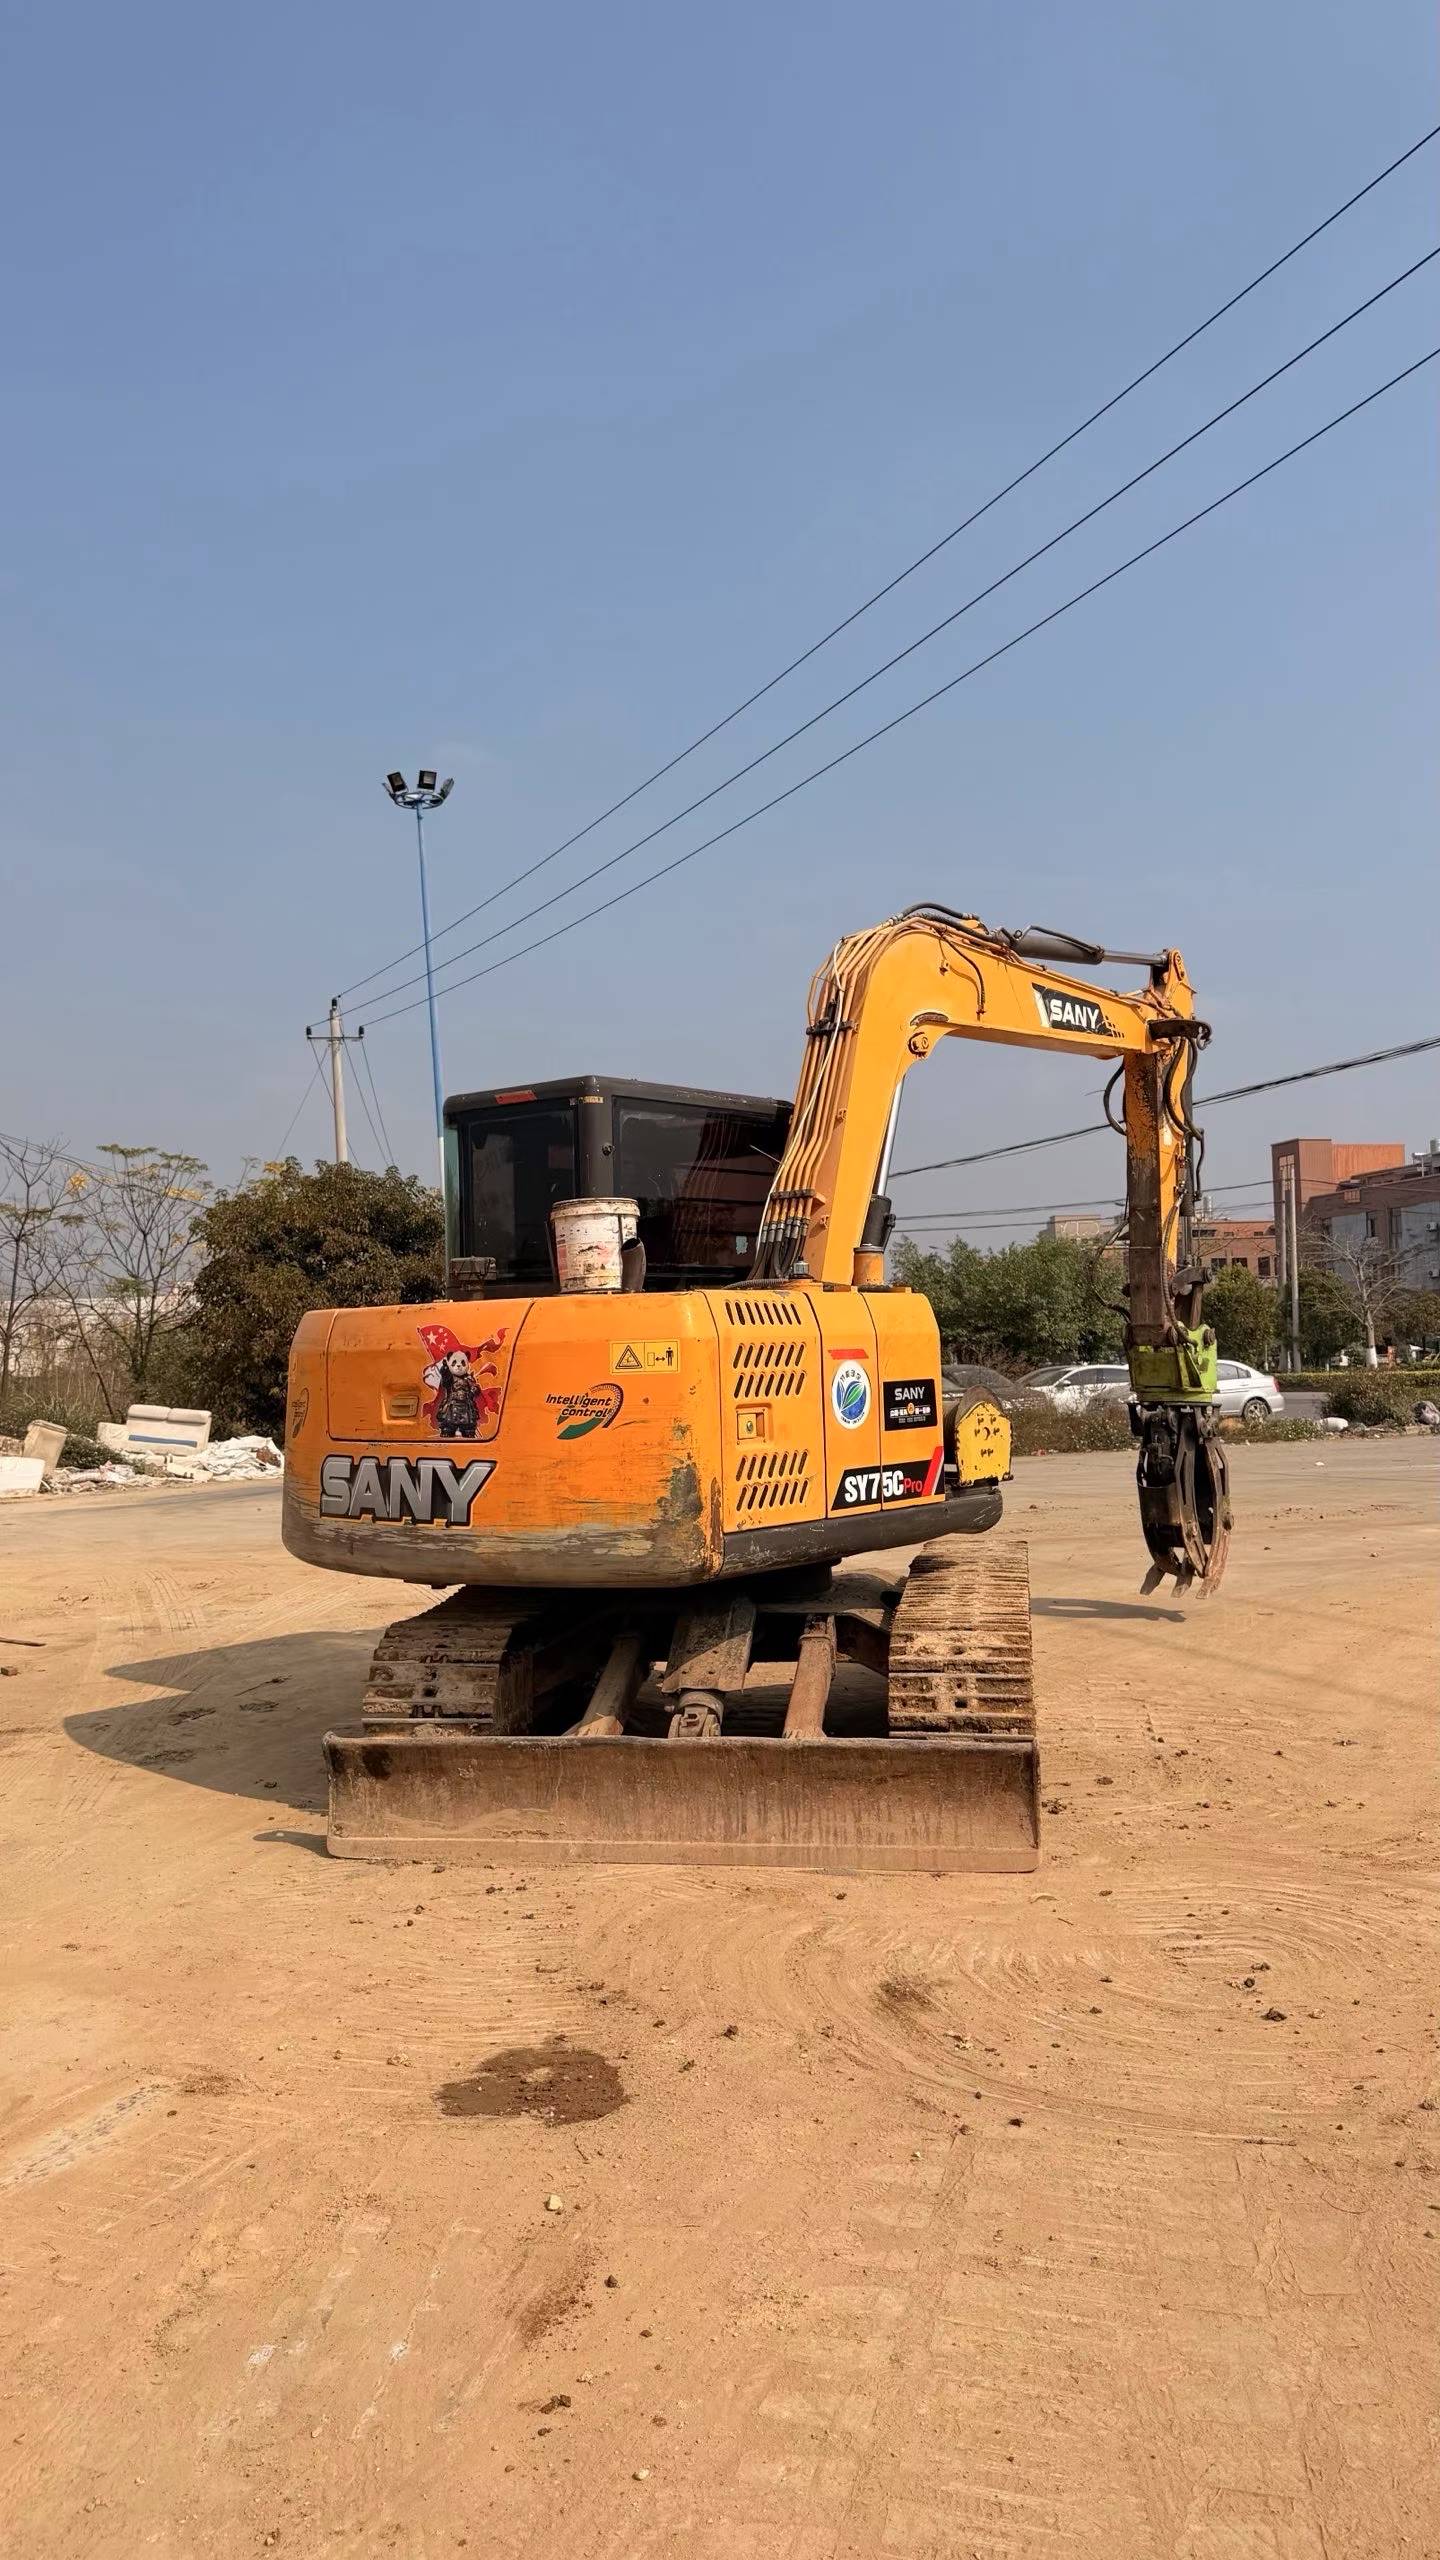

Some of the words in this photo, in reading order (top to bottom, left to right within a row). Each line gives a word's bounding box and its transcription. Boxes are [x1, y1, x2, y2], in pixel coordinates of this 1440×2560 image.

[1050, 998, 1100, 1029] SANY
[545, 1393, 612, 1408] Intelligent
[894, 1387, 925, 1401] SANY
[561, 1408, 609, 1418] control
[320, 1454, 497, 1527] SANY
